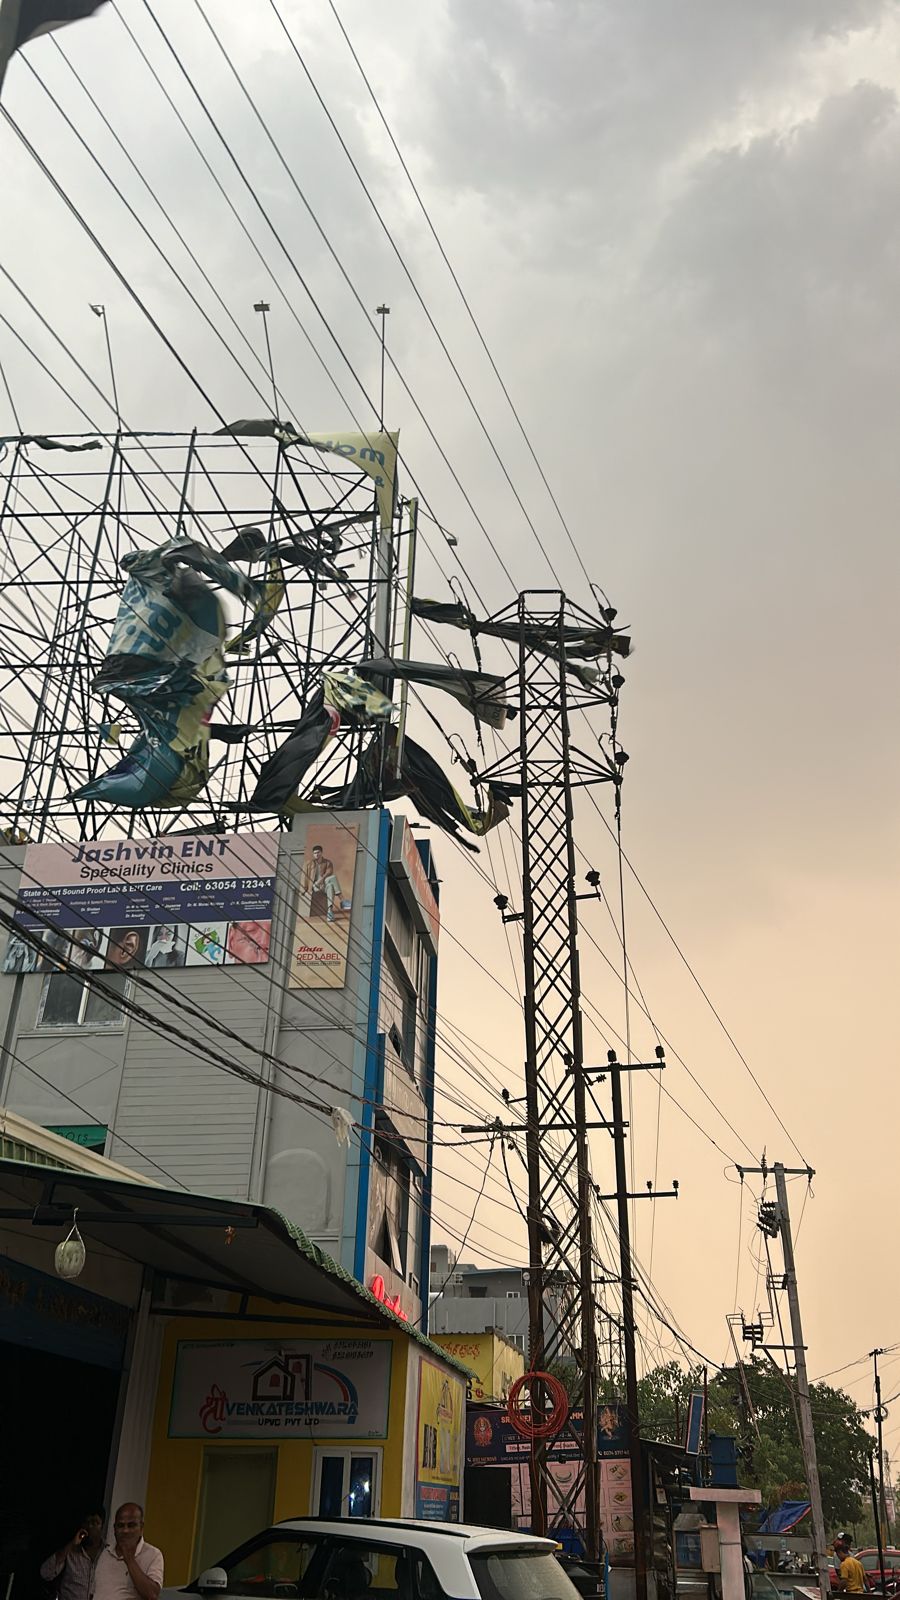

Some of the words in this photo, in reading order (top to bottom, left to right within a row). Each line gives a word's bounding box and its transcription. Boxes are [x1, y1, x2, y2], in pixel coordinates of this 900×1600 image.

[72, 841, 174, 864] Jashvin
[181, 838, 230, 858] ENT
[80, 863, 156, 881] Speciality
[160, 861, 213, 876] Clinics
[23, 890, 41, 899] State
[62, 888, 85, 896] Sound
[86, 886, 106, 894] Proof
[107, 885, 120, 893] Lab
[145, 883, 163, 892] Care
[205, 880, 237, 890] 63054
[296, 953, 313, 961] RED
[315, 953, 341, 961] LABEL
[227, 1401, 358, 1416] VENKATESHWARA
[258, 1418, 282, 1426] UPVC
[285, 1418, 301, 1426] PVT
[304, 1417, 320, 1426] LTD
